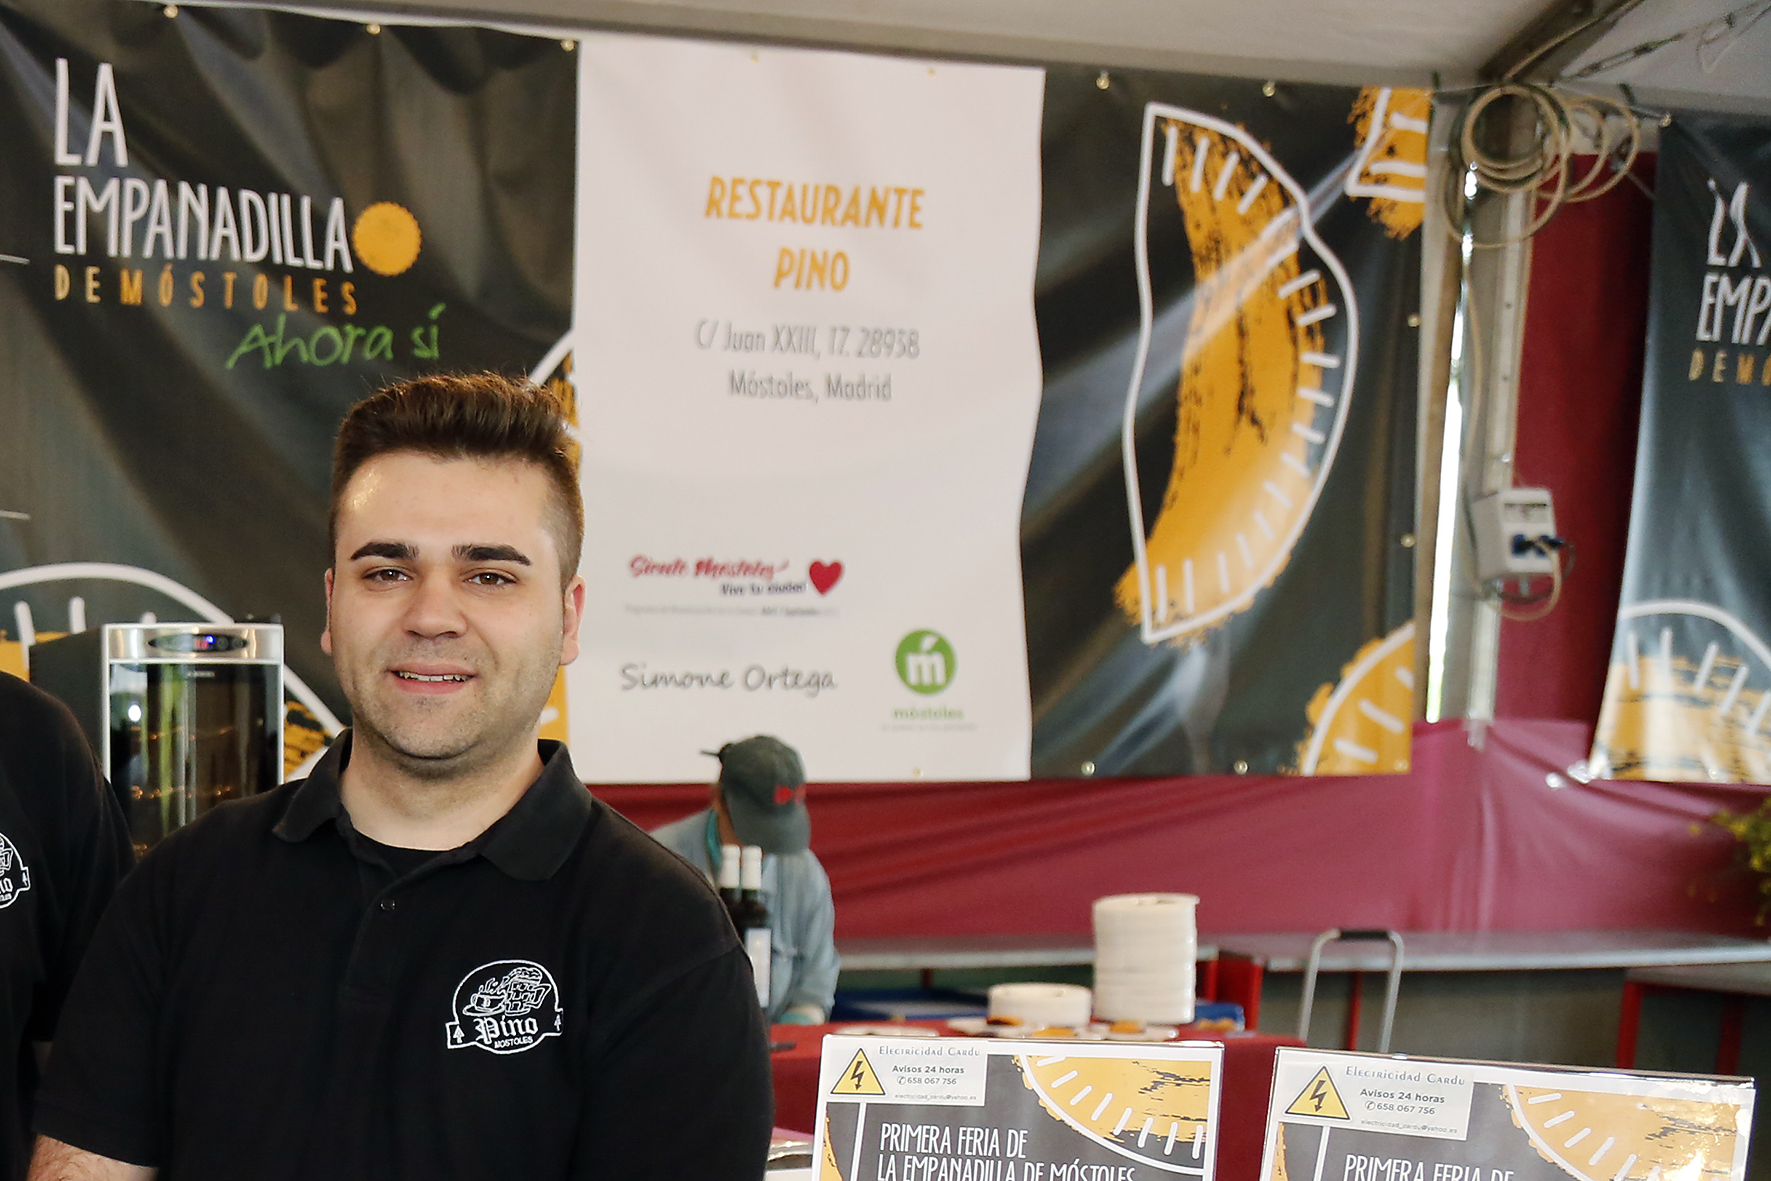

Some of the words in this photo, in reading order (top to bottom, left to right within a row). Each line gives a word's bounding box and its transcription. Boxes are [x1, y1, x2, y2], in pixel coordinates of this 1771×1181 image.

[54, 58, 129, 167] LA
[704, 176, 925, 230] RESTAURANTE
[54, 175, 354, 273] EMPANADILLA
[773, 247, 849, 291] PINO
[54, 265, 102, 303] DE
[120, 263, 357, 316] MÓSTOLES
[226, 313, 394, 369] Ahora
[411, 304, 446, 360] sí
[695, 318, 719, 350] C/
[727, 323, 765, 352] Juan
[772, 325, 820, 359] XXIII,
[730, 370, 818, 402] Móstoles,
[827, 374, 892, 401] Madrid
[620, 664, 734, 692] Simone
[743, 665, 838, 697] Ortega
[473, 1015, 538, 1044] Pino
[495, 1036, 533, 1048] MOSTOLES
[879, 1046, 943, 1056] Electricidad
[948, 1047, 980, 1056] Cardu
[1346, 1066, 1421, 1082] Electricidad
[1427, 1073, 1465, 1085] Cardu
[1360, 1089, 1394, 1099] Avisos
[1398, 1092, 1411, 1100] 24
[1415, 1093, 1445, 1103] horas
[1377, 1103, 1394, 1111] 658
[1418, 1106, 1435, 1114] 756
[880, 1123, 951, 1155] PRIMERA
[957, 1127, 1000, 1157] FERIA
[1007, 1129, 1028, 1159] DE
[877, 1153, 897, 1181] LA
